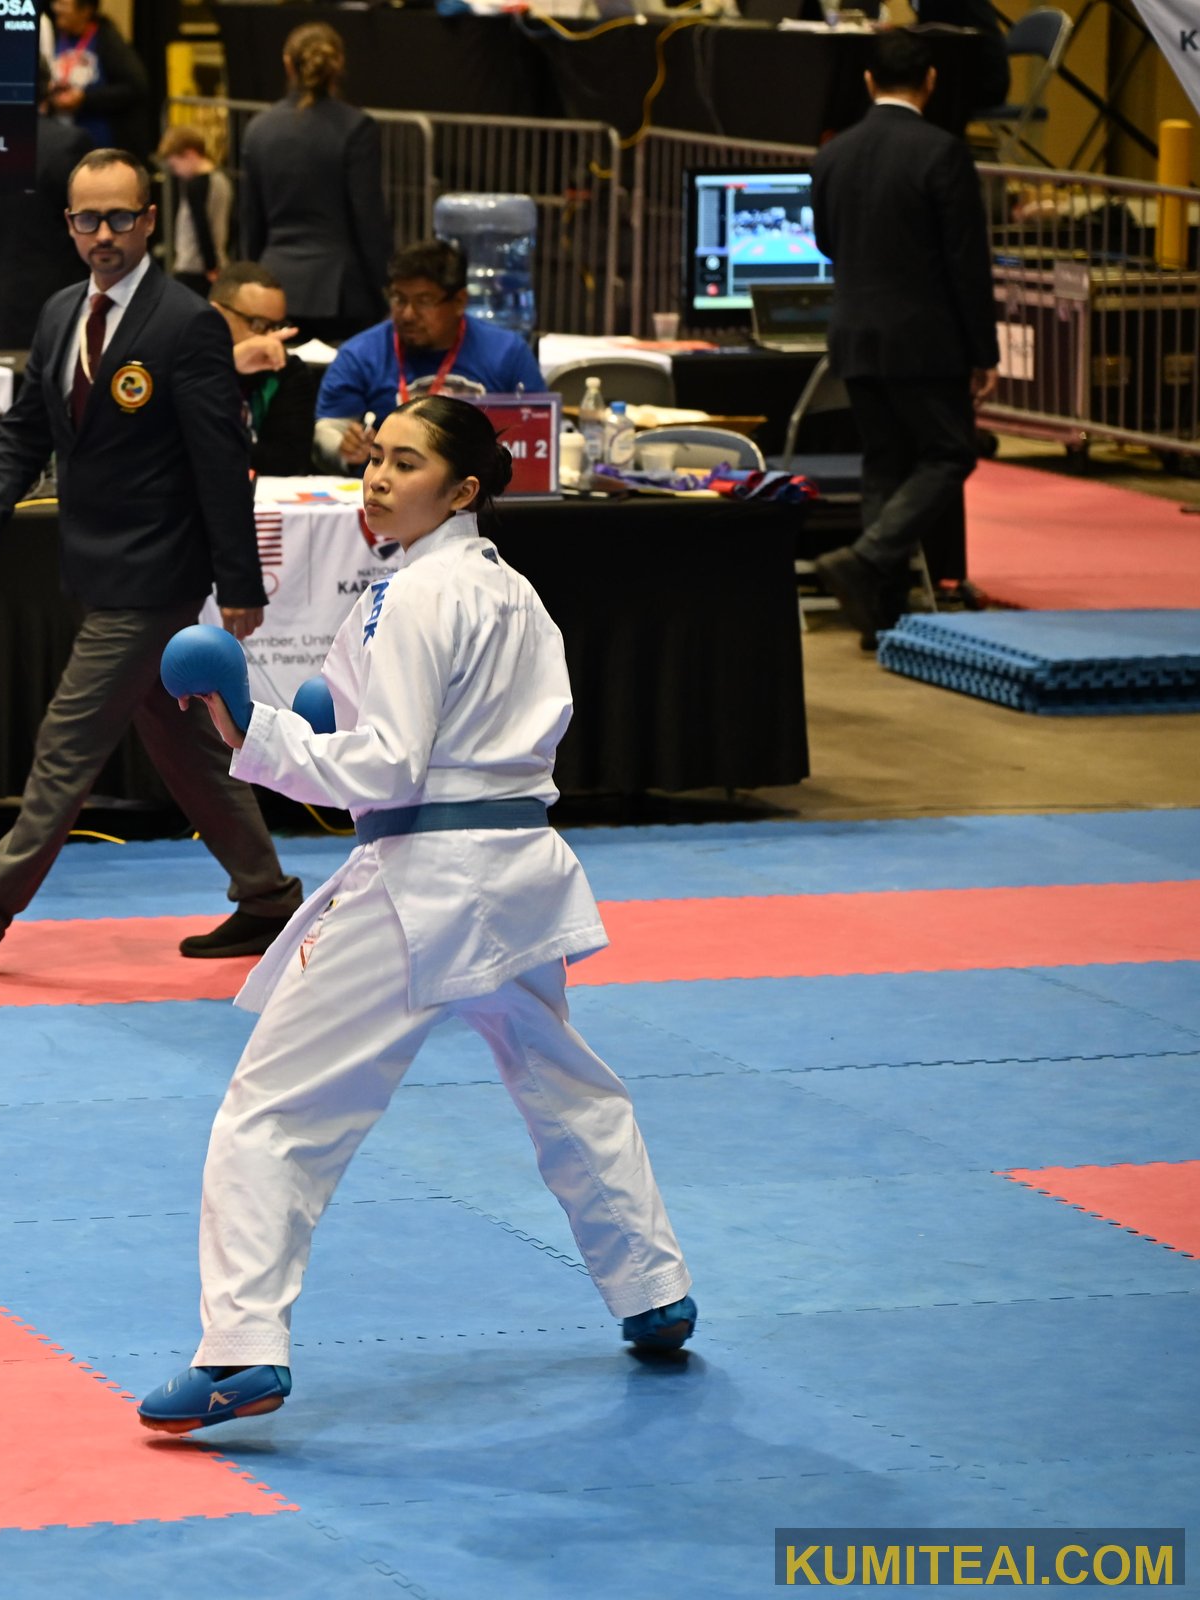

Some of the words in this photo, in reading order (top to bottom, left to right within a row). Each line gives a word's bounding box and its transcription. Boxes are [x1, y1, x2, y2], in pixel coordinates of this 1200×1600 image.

[4, 20, 36, 31] KIARA
[535, 440, 548, 459] 2
[246, 636, 298, 649] ember,
